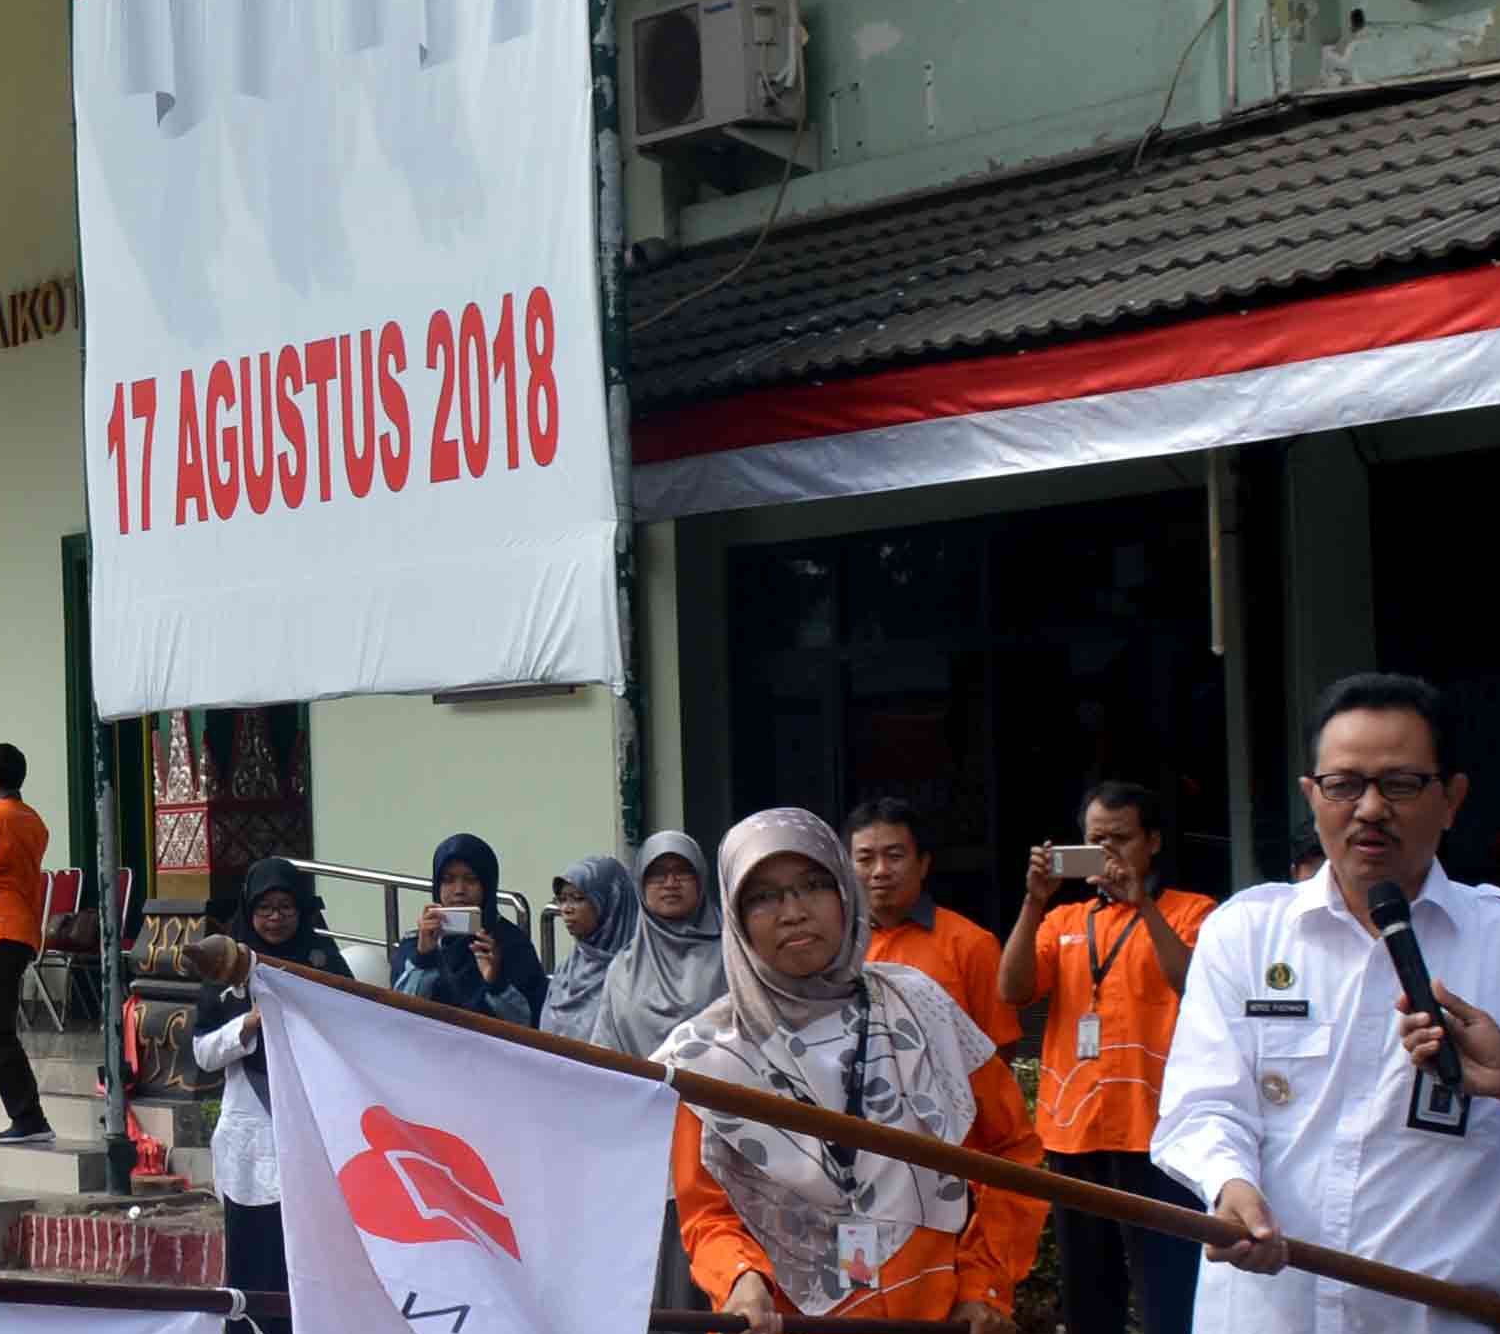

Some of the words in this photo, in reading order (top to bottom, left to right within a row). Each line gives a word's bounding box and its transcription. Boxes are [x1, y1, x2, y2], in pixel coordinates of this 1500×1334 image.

[107, 376, 156, 536] 17
[175, 320, 412, 527] AGUSTUS
[426, 285, 560, 484] 2018
